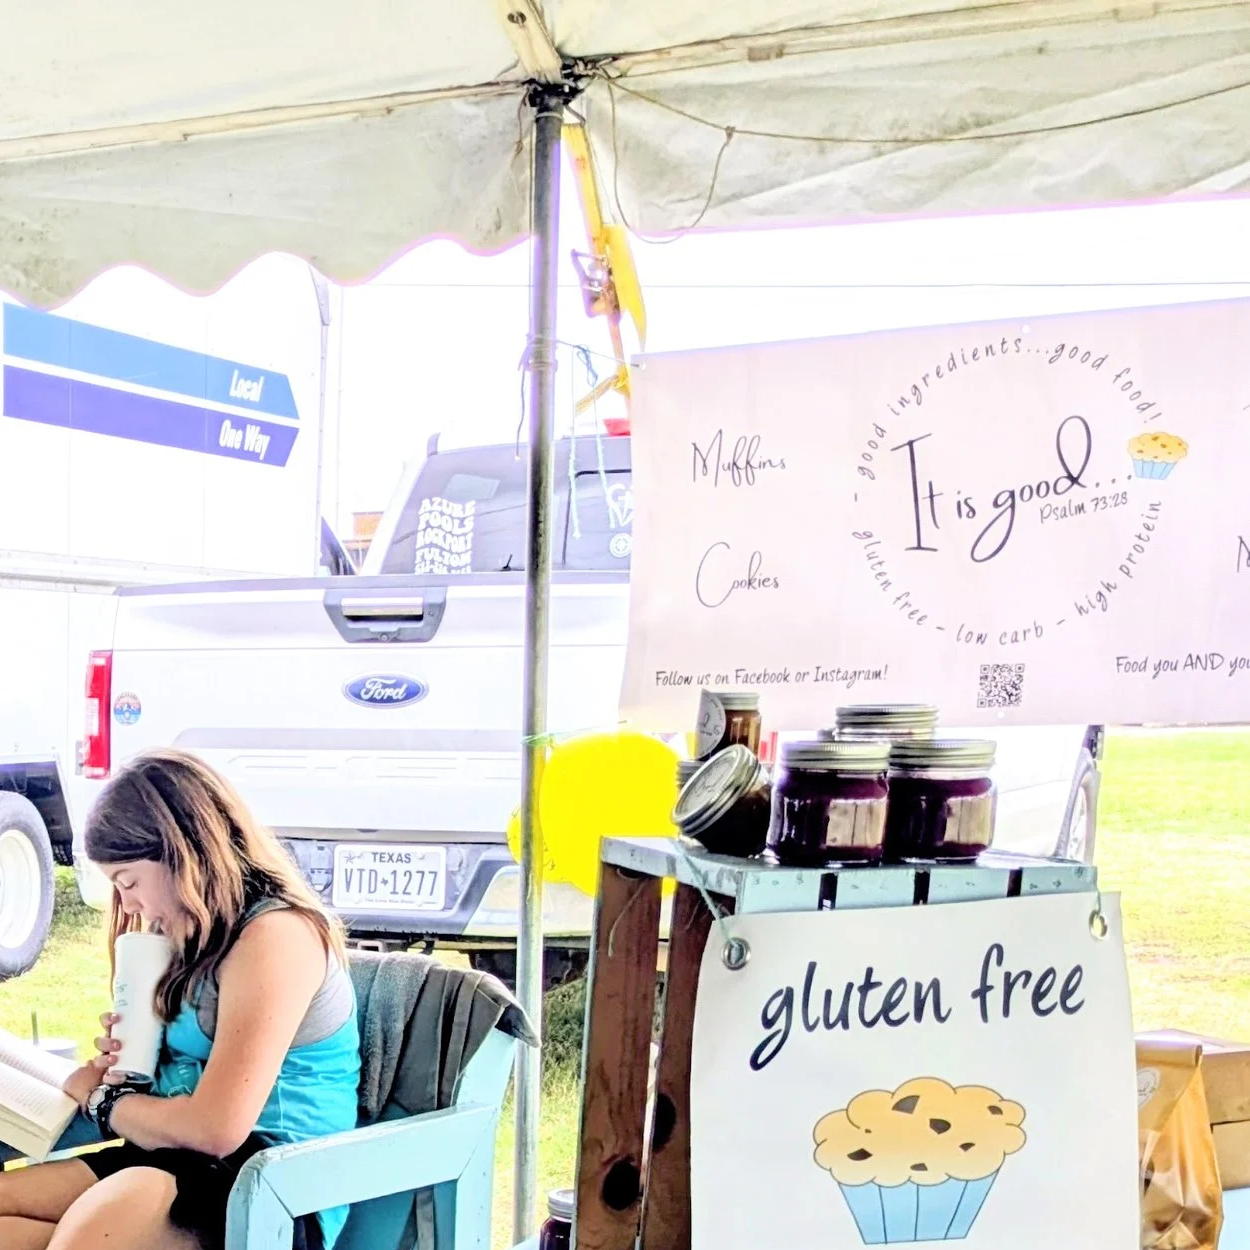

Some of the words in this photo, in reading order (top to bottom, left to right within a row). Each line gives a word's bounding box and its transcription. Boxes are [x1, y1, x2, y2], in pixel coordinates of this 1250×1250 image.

[229, 369, 265, 402] Local
[219, 419, 243, 449] One
[244, 424, 271, 461] Way
[857, 423, 887, 480] good
[1113, 367, 1162, 424] food!
[691, 428, 786, 487] Muffins
[418, 497, 475, 518] AZURE
[890, 433, 943, 552] It
[957, 490, 976, 519] is
[1040, 499, 1086, 524] Psalm
[1090, 491, 1128, 512] 73:28
[418, 511, 474, 535] POOLS
[696, 541, 780, 608] Cookies
[852, 531, 892, 592] gluten
[893, 591, 928, 625] free
[956, 624, 988, 645] low
[999, 620, 1043, 645] carb
[1075, 580, 1118, 612] high
[1119, 501, 1162, 579] protein
[655, 670, 693, 686] Follow
[696, 671, 711, 685] us
[715, 673, 730, 685] on
[735, 667, 791, 684] Facebook
[795, 671, 810, 683] or
[814, 664, 888, 688] Instagram!
[1116, 656, 1149, 673] Food
[1152, 660, 1179, 680] you
[1183, 653, 1225, 671] AND
[360, 678, 407, 700] Ford
[371, 852, 411, 863] TEXAS
[750, 961, 952, 1071] gluten
[971, 943, 1085, 1023] free
